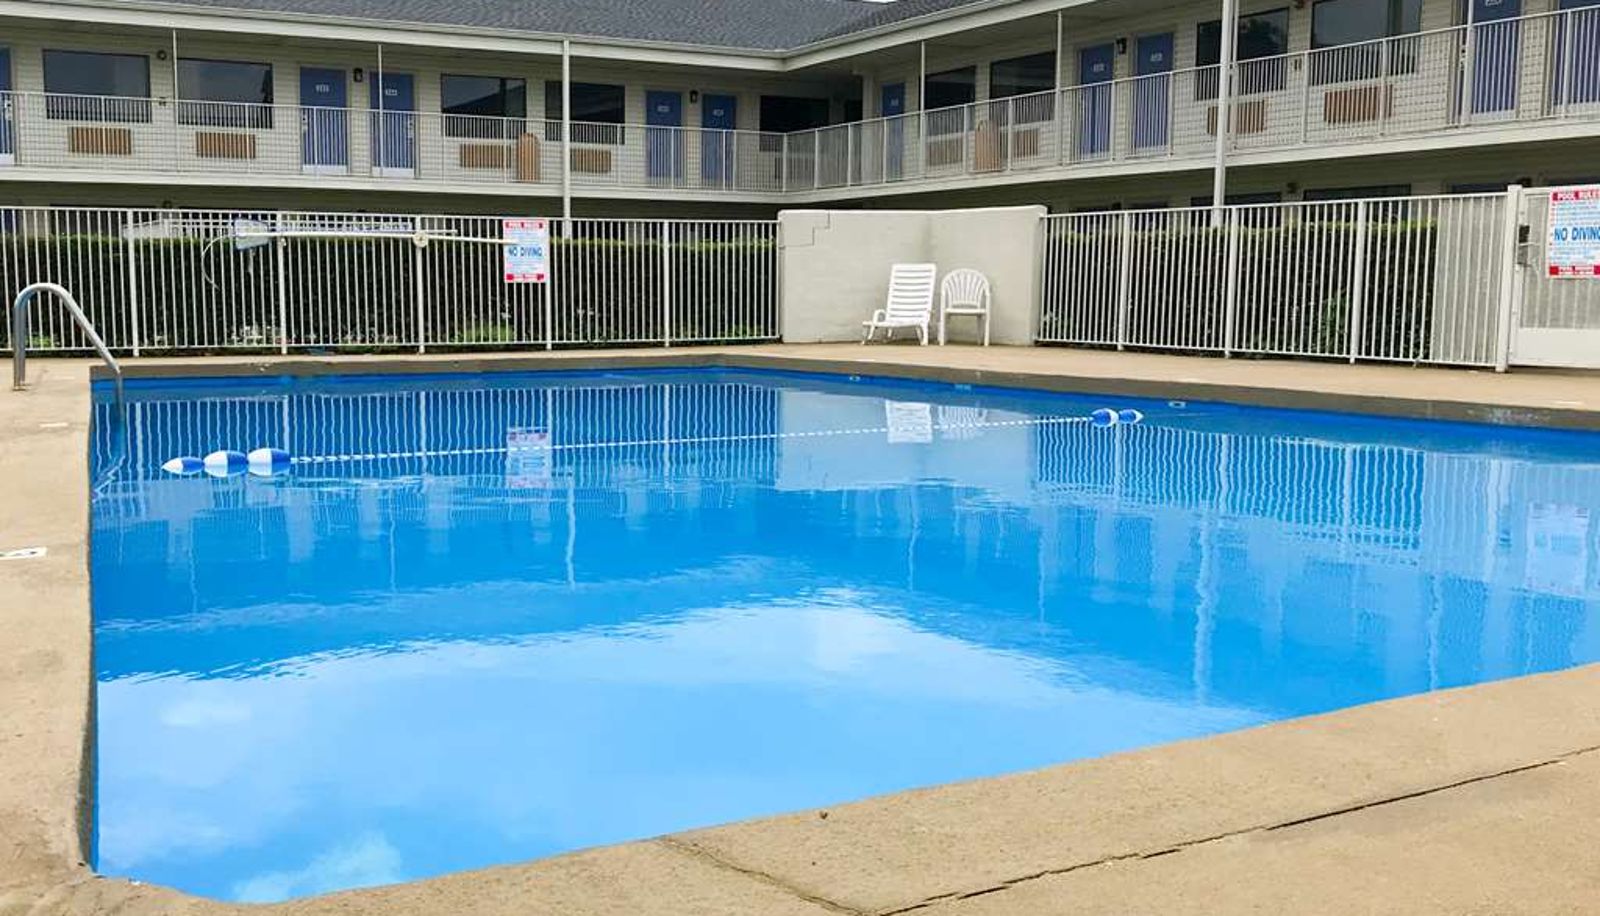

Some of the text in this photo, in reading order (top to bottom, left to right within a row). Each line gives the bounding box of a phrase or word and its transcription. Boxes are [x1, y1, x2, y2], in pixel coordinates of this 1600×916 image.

[1557, 191, 1574, 201] POOL
[1554, 227, 1568, 241] NO
[508, 246, 543, 257] NO DIVING
